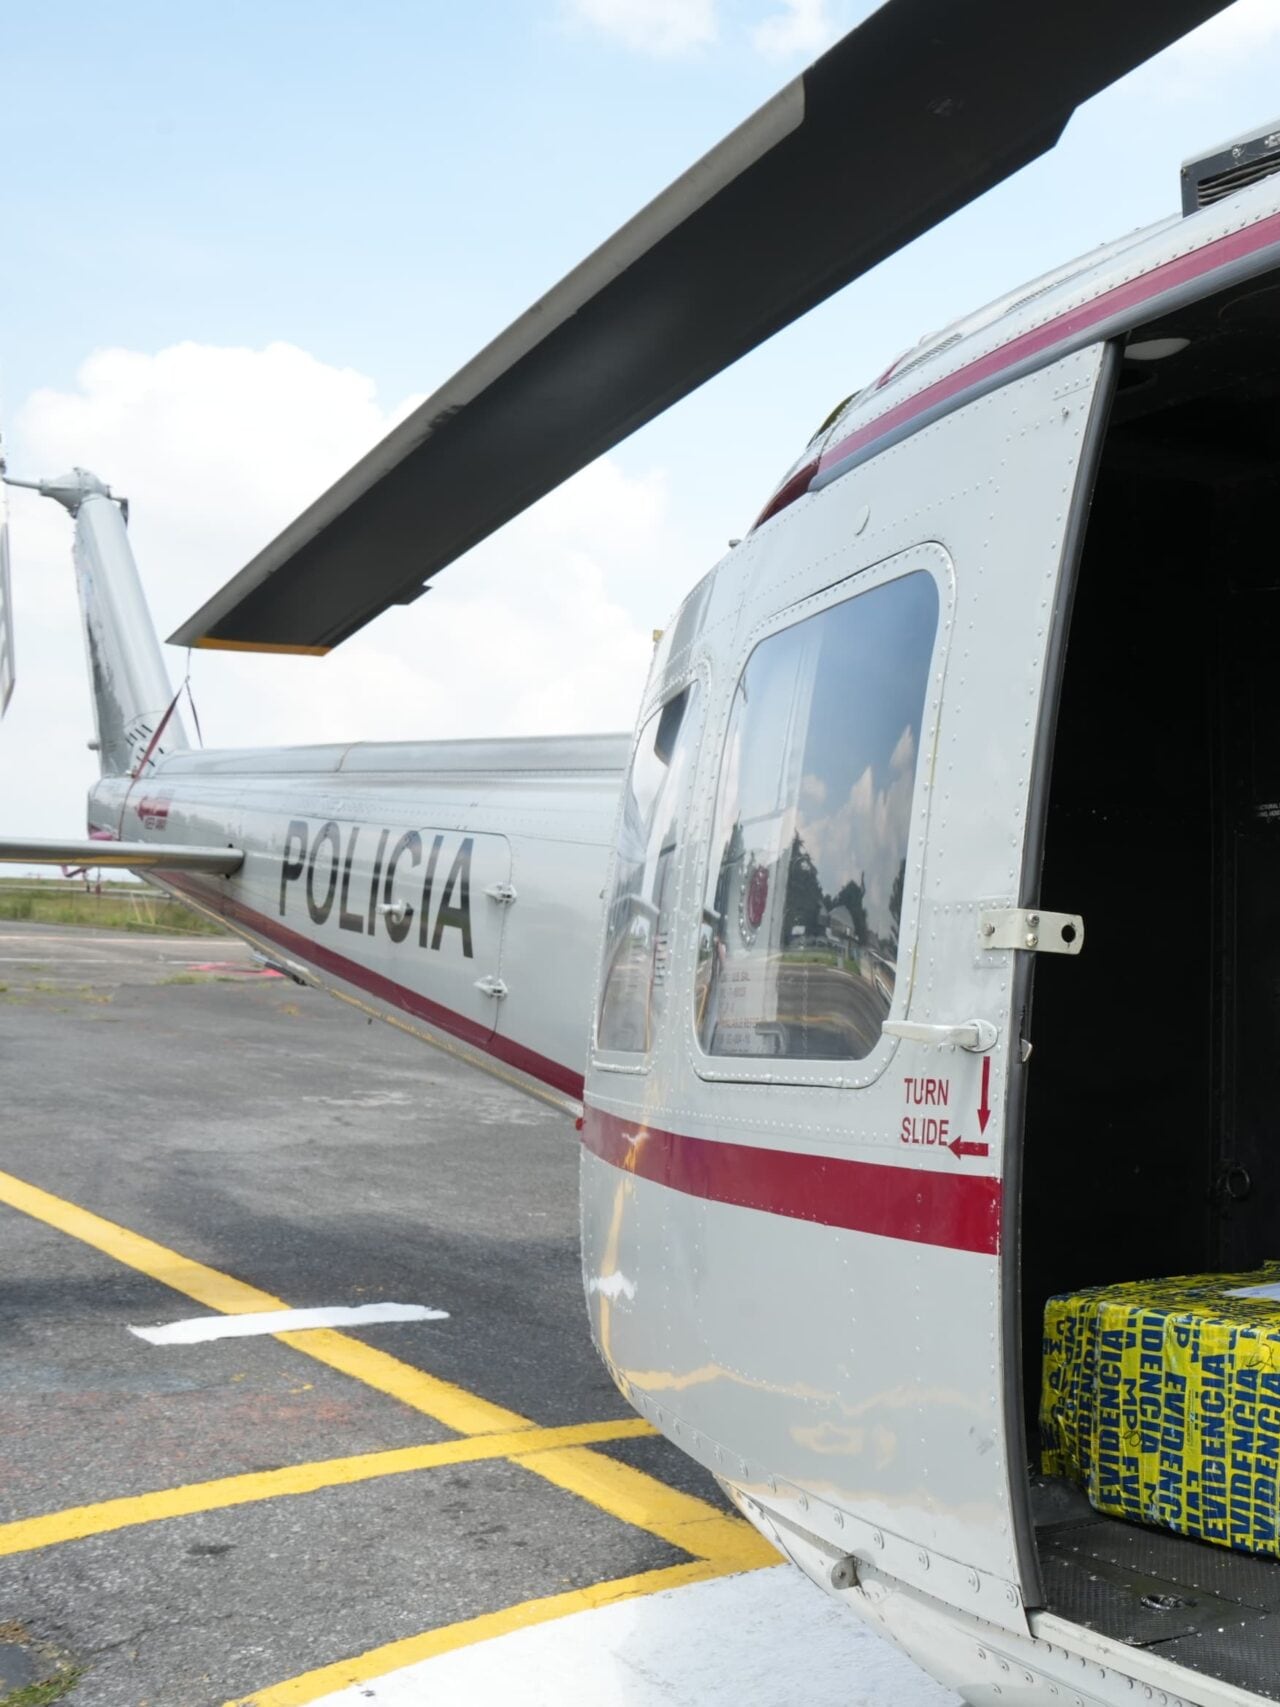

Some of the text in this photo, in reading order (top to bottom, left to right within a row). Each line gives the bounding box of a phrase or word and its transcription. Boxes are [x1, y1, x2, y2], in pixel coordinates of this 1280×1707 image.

[279, 820, 474, 959] POLICIA
[901, 1117, 949, 1146] SLIDE
[904, 1078, 949, 1105] TURN
[1100, 1329, 1124, 1505] EVIDENCIA
[1122, 1378, 1138, 1430] MP
[1139, 1315, 1165, 1454] IDENCIA
[1202, 1354, 1228, 1540] EVIDENCIA
[1231, 1368, 1259, 1551] EVIDENCIA
